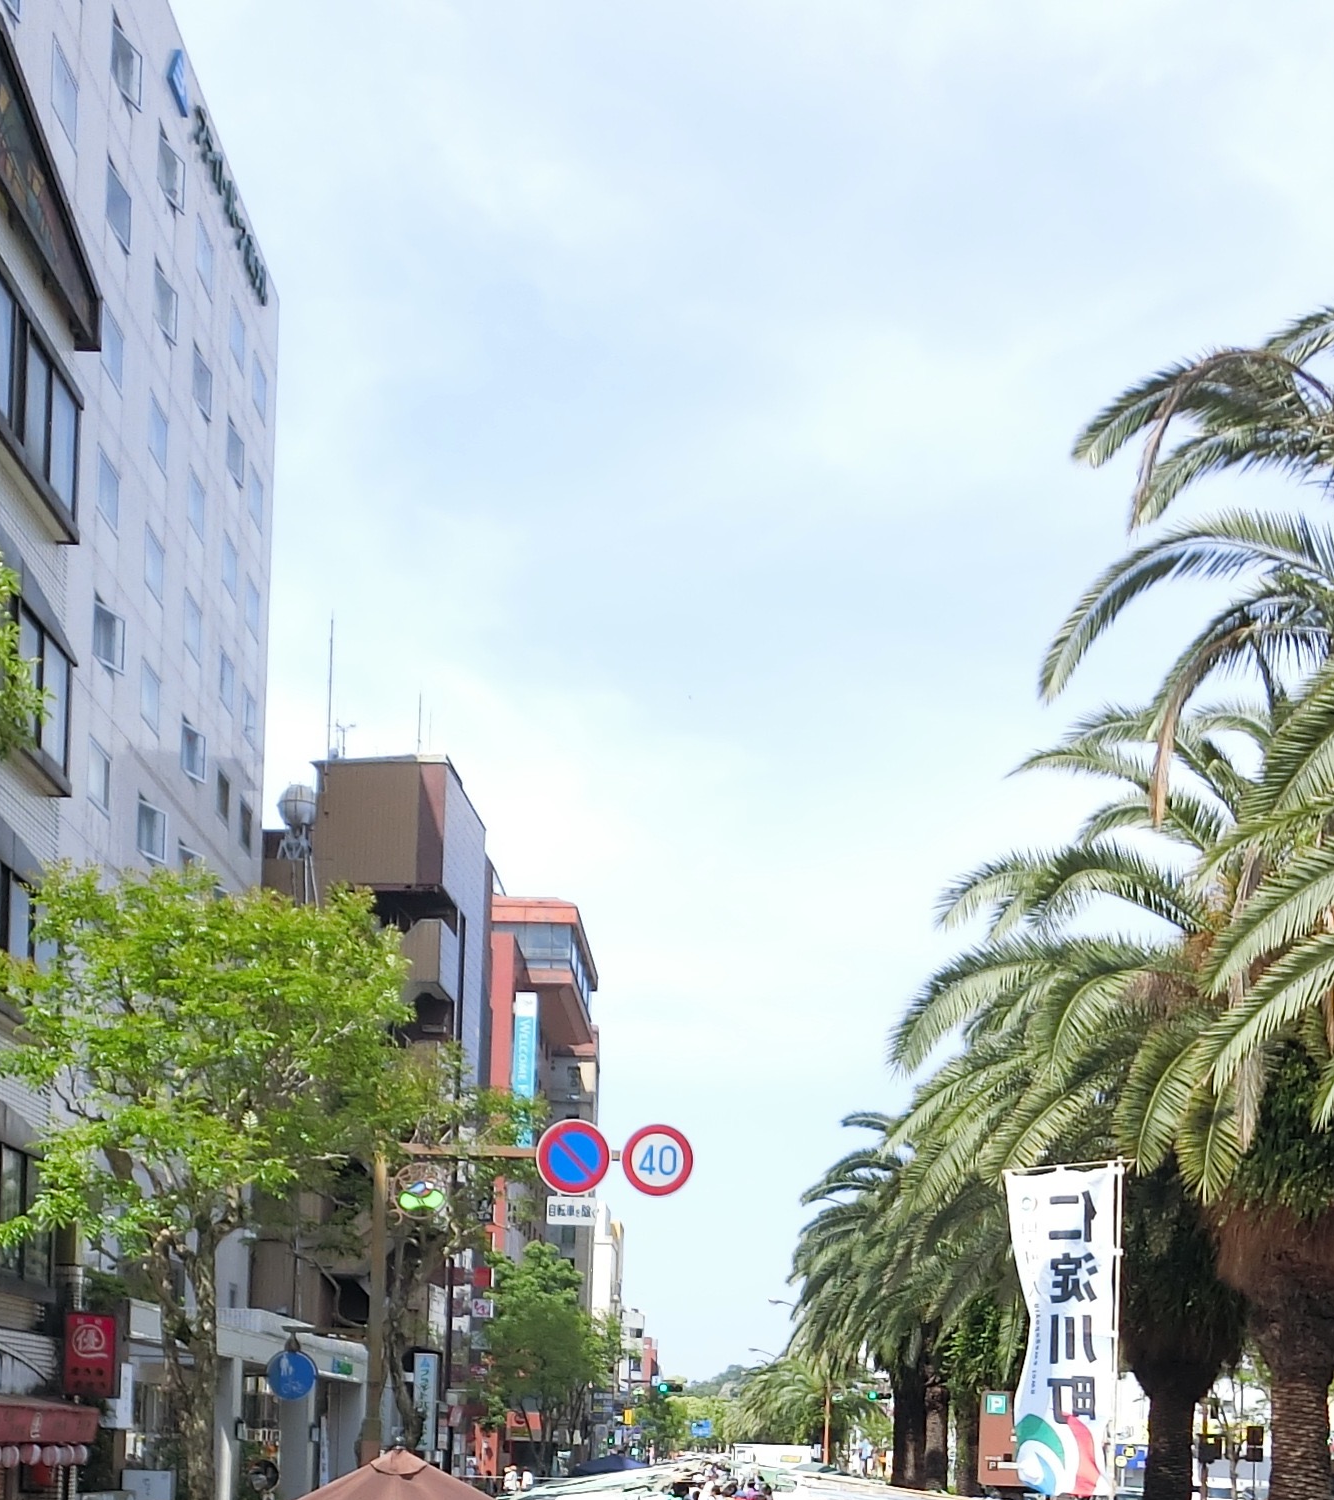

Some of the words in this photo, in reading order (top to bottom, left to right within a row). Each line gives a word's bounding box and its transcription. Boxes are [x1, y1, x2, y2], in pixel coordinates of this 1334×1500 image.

[518, 1019, 532, 1081] WELCOME
[639, 1144, 677, 1176] 40
[548, 1203, 599, 1219] 自転車を除く
